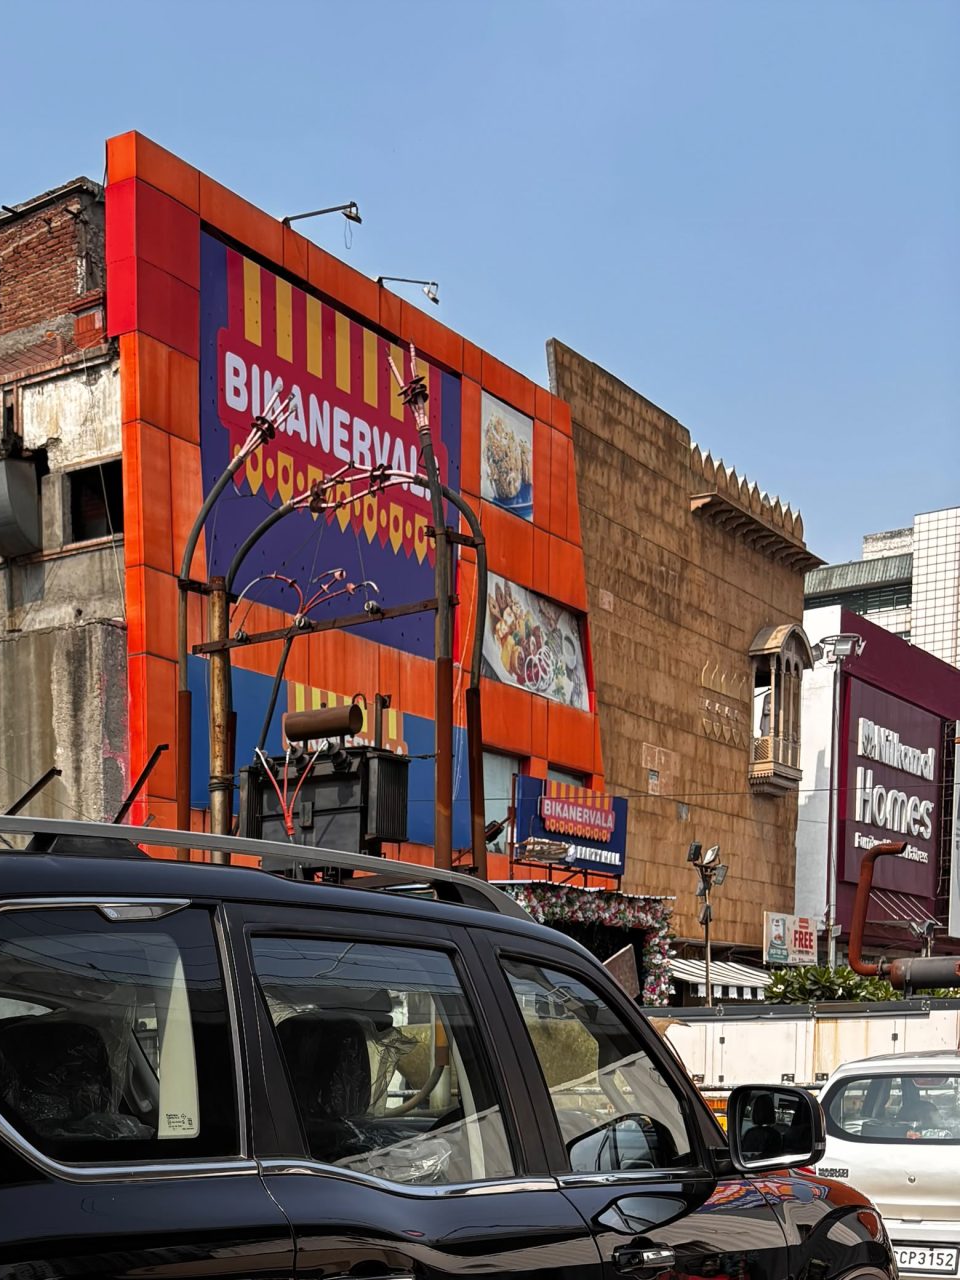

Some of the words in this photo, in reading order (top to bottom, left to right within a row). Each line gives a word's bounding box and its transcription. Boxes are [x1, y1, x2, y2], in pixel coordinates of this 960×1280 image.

[874, 724, 935, 781] Nilkamal
[543, 799, 613, 830] BIKANERVALA
[855, 766, 932, 840] Homes
[793, 929, 814, 950] FREE
